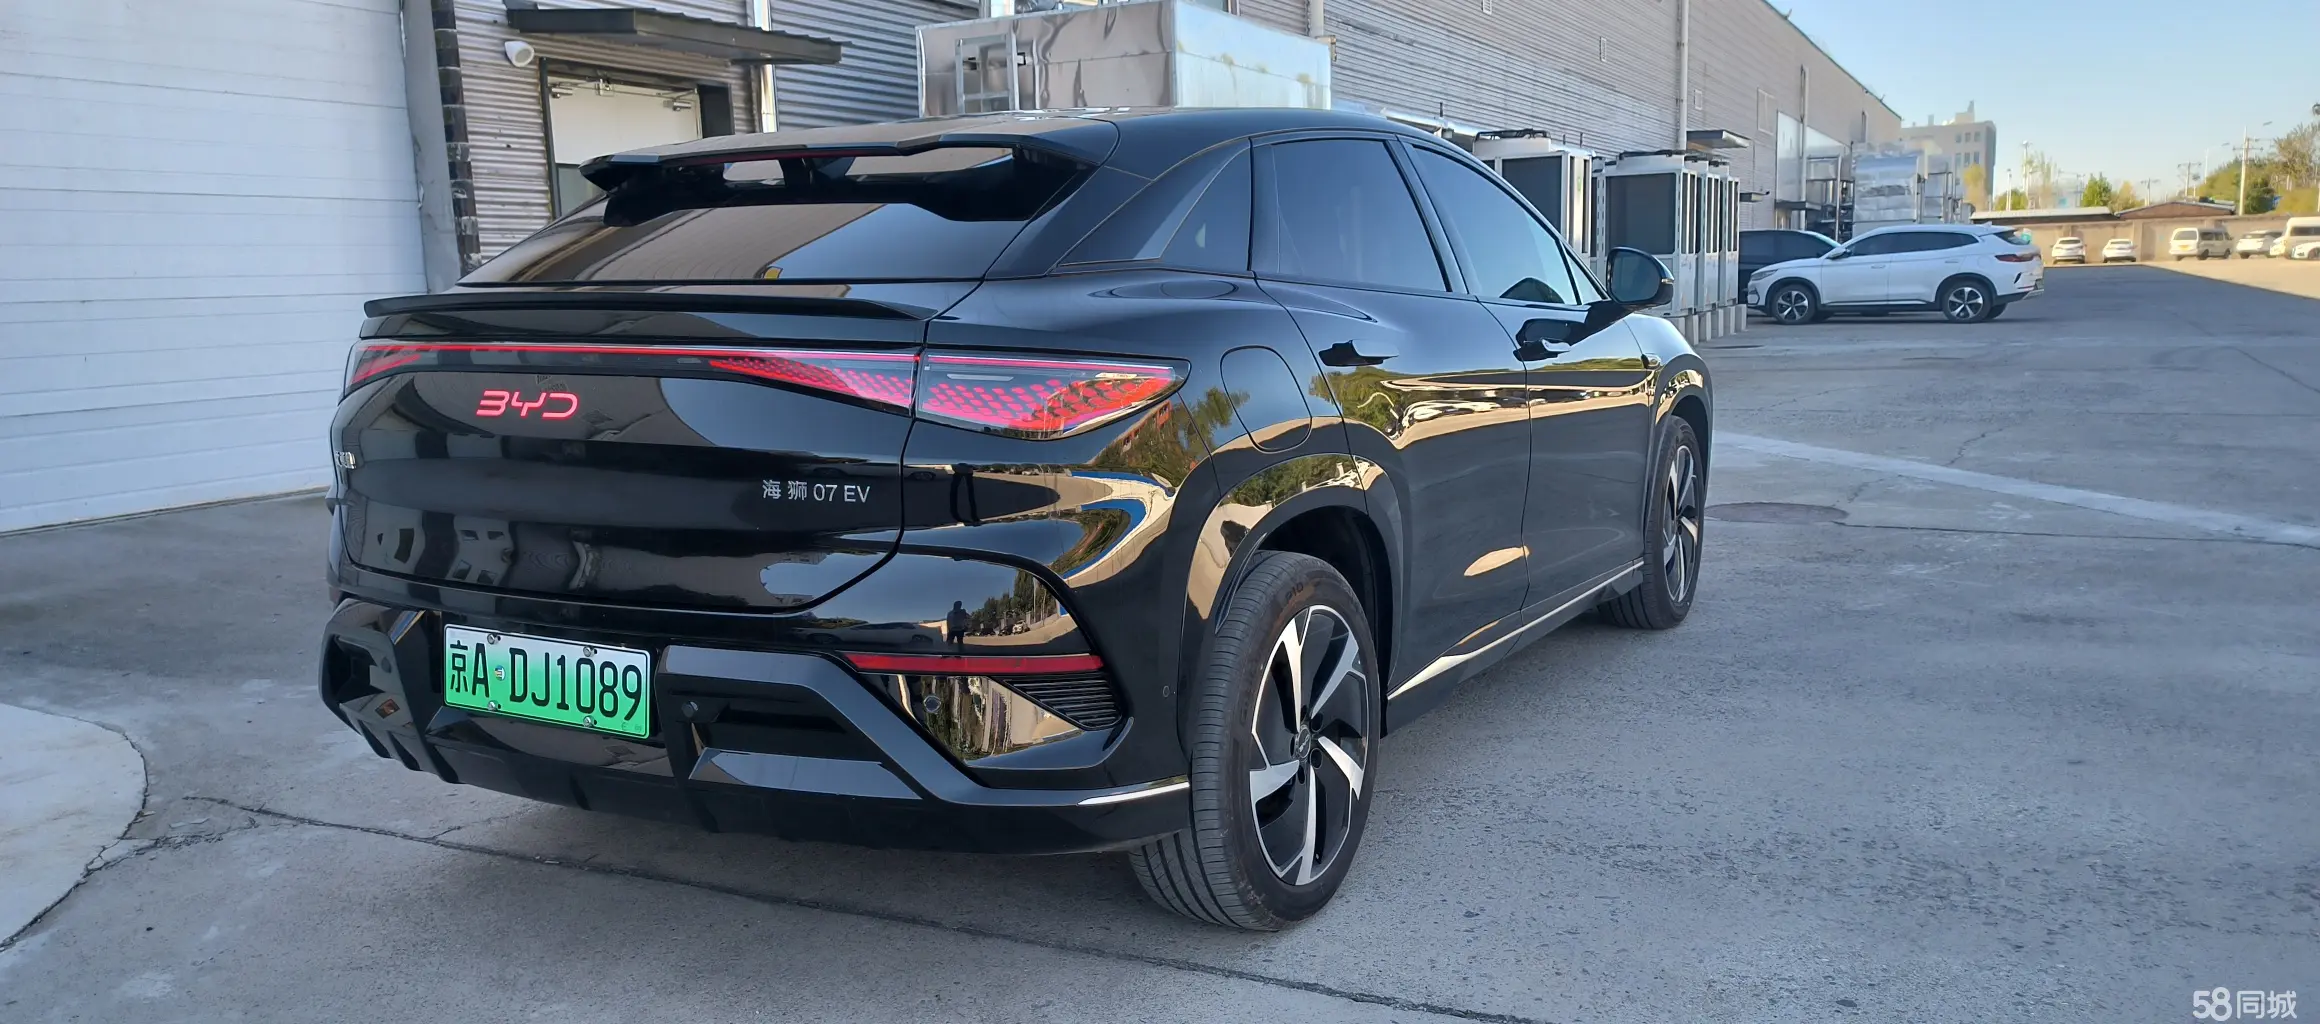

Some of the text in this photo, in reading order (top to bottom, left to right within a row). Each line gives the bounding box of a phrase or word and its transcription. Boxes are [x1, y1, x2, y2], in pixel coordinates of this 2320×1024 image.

[476, 389, 579, 419] BYD
[813, 483, 838, 502] 07
[843, 484, 871, 503] EV
